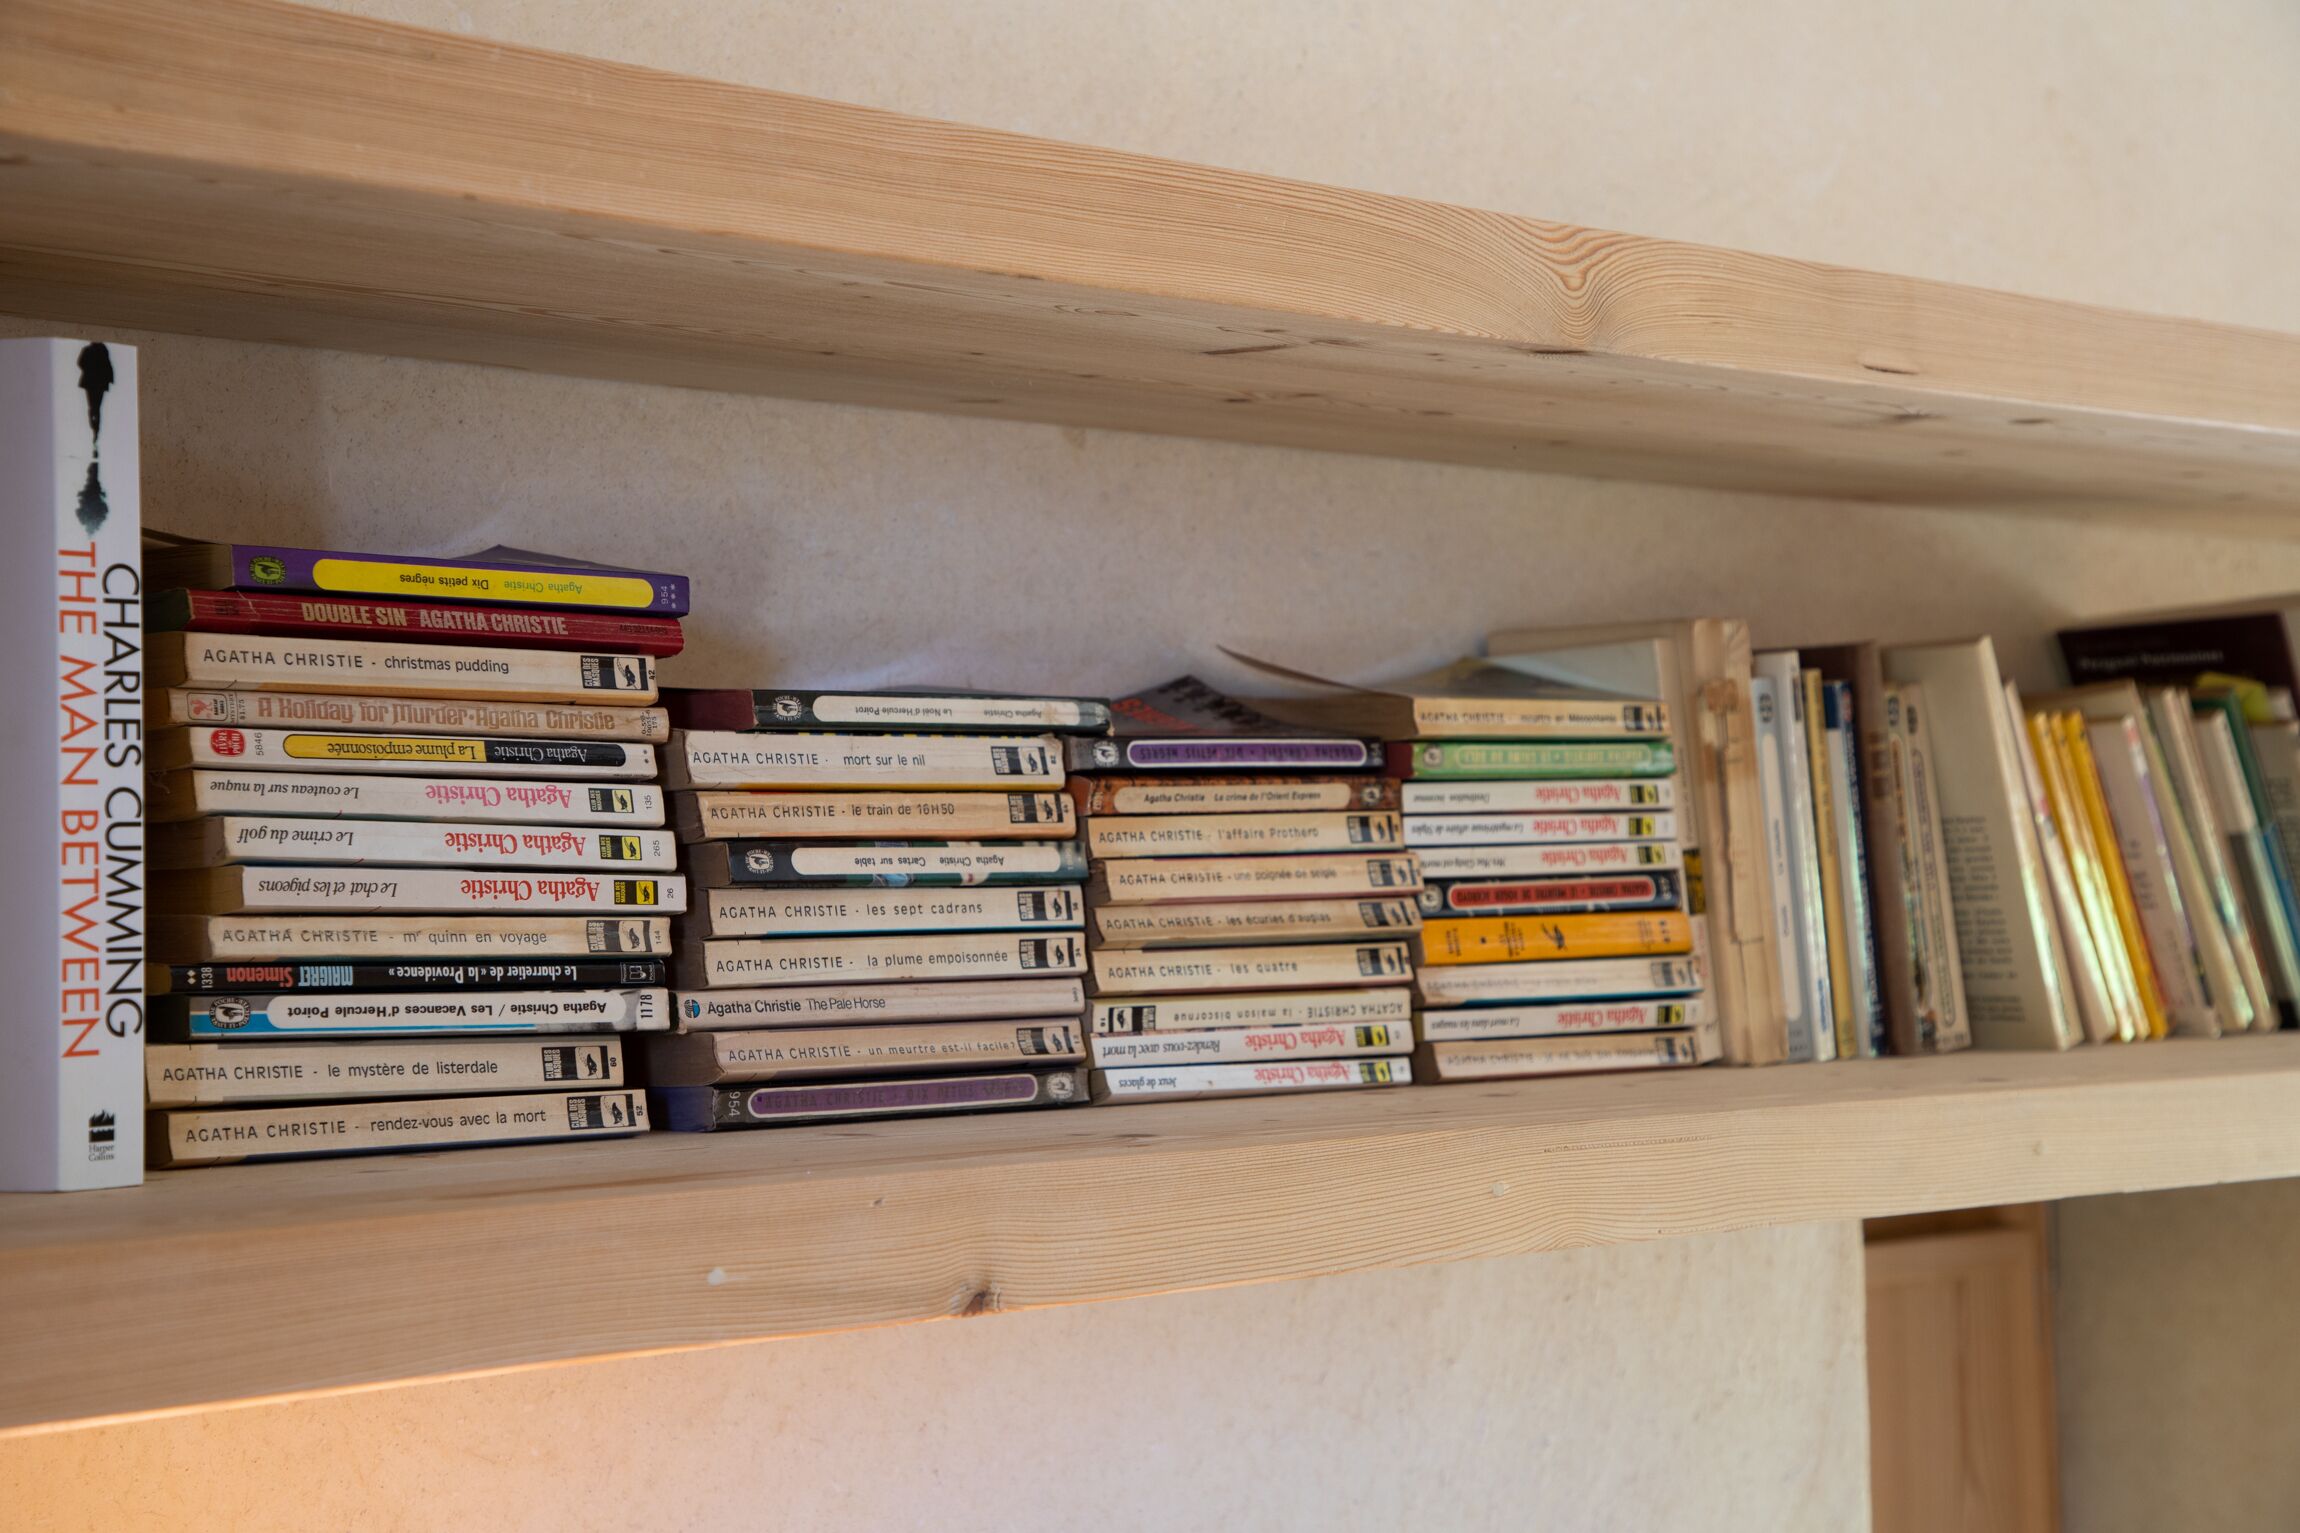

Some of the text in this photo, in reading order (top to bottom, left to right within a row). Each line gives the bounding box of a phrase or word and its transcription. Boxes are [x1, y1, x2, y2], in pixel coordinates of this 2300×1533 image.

[400, 573, 583, 594] Agatha Christie Dix petits nègres
[661, 586, 669, 604] 954
[302, 603, 568, 635] DOUBLE SIN AGATHA CHRISTIE
[203, 649, 509, 674] AGATHA CHRISTIE christmas pudding
[648, 669, 655, 680] 42
[258, 699, 272, 717] A
[278, 698, 353, 723] Holiday
[358, 702, 389, 723] for
[545, 709, 615, 730] Christie
[255, 732, 263, 756] 5846
[327, 742, 587, 763] Agatha Christie La plume empoisonnée
[693, 752, 925, 766] AGATHA CHRISTIE mort sur le nil
[58, 541, 100, 1060] THE MAN BETWEEN
[102, 562, 143, 1038] CHARLES CUMMING
[210, 780, 572, 808] Agatha Christie Le couteau sur la nuque
[711, 807, 766, 819] AGATHA
[773, 805, 835, 818] CHRISTIE
[852, 804, 862, 816] le
[866, 804, 893, 816] train
[898, 804, 912, 815] de
[237, 826, 586, 856] Agatha Christie Le crime du golf
[259, 877, 600, 900] Agatha Christie Le chat et les pigeons
[667, 887, 674, 899] 26
[719, 902, 983, 918] AGATHA CHRISTIE les sept cadrans
[222, 929, 291, 943] AGATHA
[301, 929, 377, 943] CHRISTIE
[428, 931, 467, 944] quinn
[475, 931, 491, 943] en
[500, 932, 547, 945] voyage
[716, 951, 1008, 972] AGATHA CHRISTIE la plume empoisonnée
[202, 968, 213, 988] 1338
[227, 966, 353, 986] Simenon MAIGRET
[396, 966, 577, 983] Le charretier de la Providence
[287, 1001, 606, 1019] Agatha Christie Les Vacances d'Hercule Poirot
[641, 994, 652, 1019] 1178
[707, 997, 886, 1015] Agatha Christie The Pale Horse
[1174, 1003, 1403, 1021] AGATHA CHRISTIE la maison biscornue
[728, 1041, 1015, 1061] AGATHA CHRISTIE un meurtre est-il facile?
[1102, 1027, 1346, 1058] Agatha Christie Rendez-vous avec la mort
[163, 1060, 498, 1081] AGATHA CHRISTIE le mystère de listerdale
[610, 1057, 617, 1067] 60
[1119, 1064, 1350, 1088] Agatha Christie Jeux de glaces
[569, 1098, 577, 1111] DES
[577, 1098, 588, 1127] MASQUES
[635, 1105, 642, 1116] 52
[729, 1092, 739, 1116] 954
[186, 1109, 546, 1142] AGATHA CHRISTIE rendez-vous avec la mort
